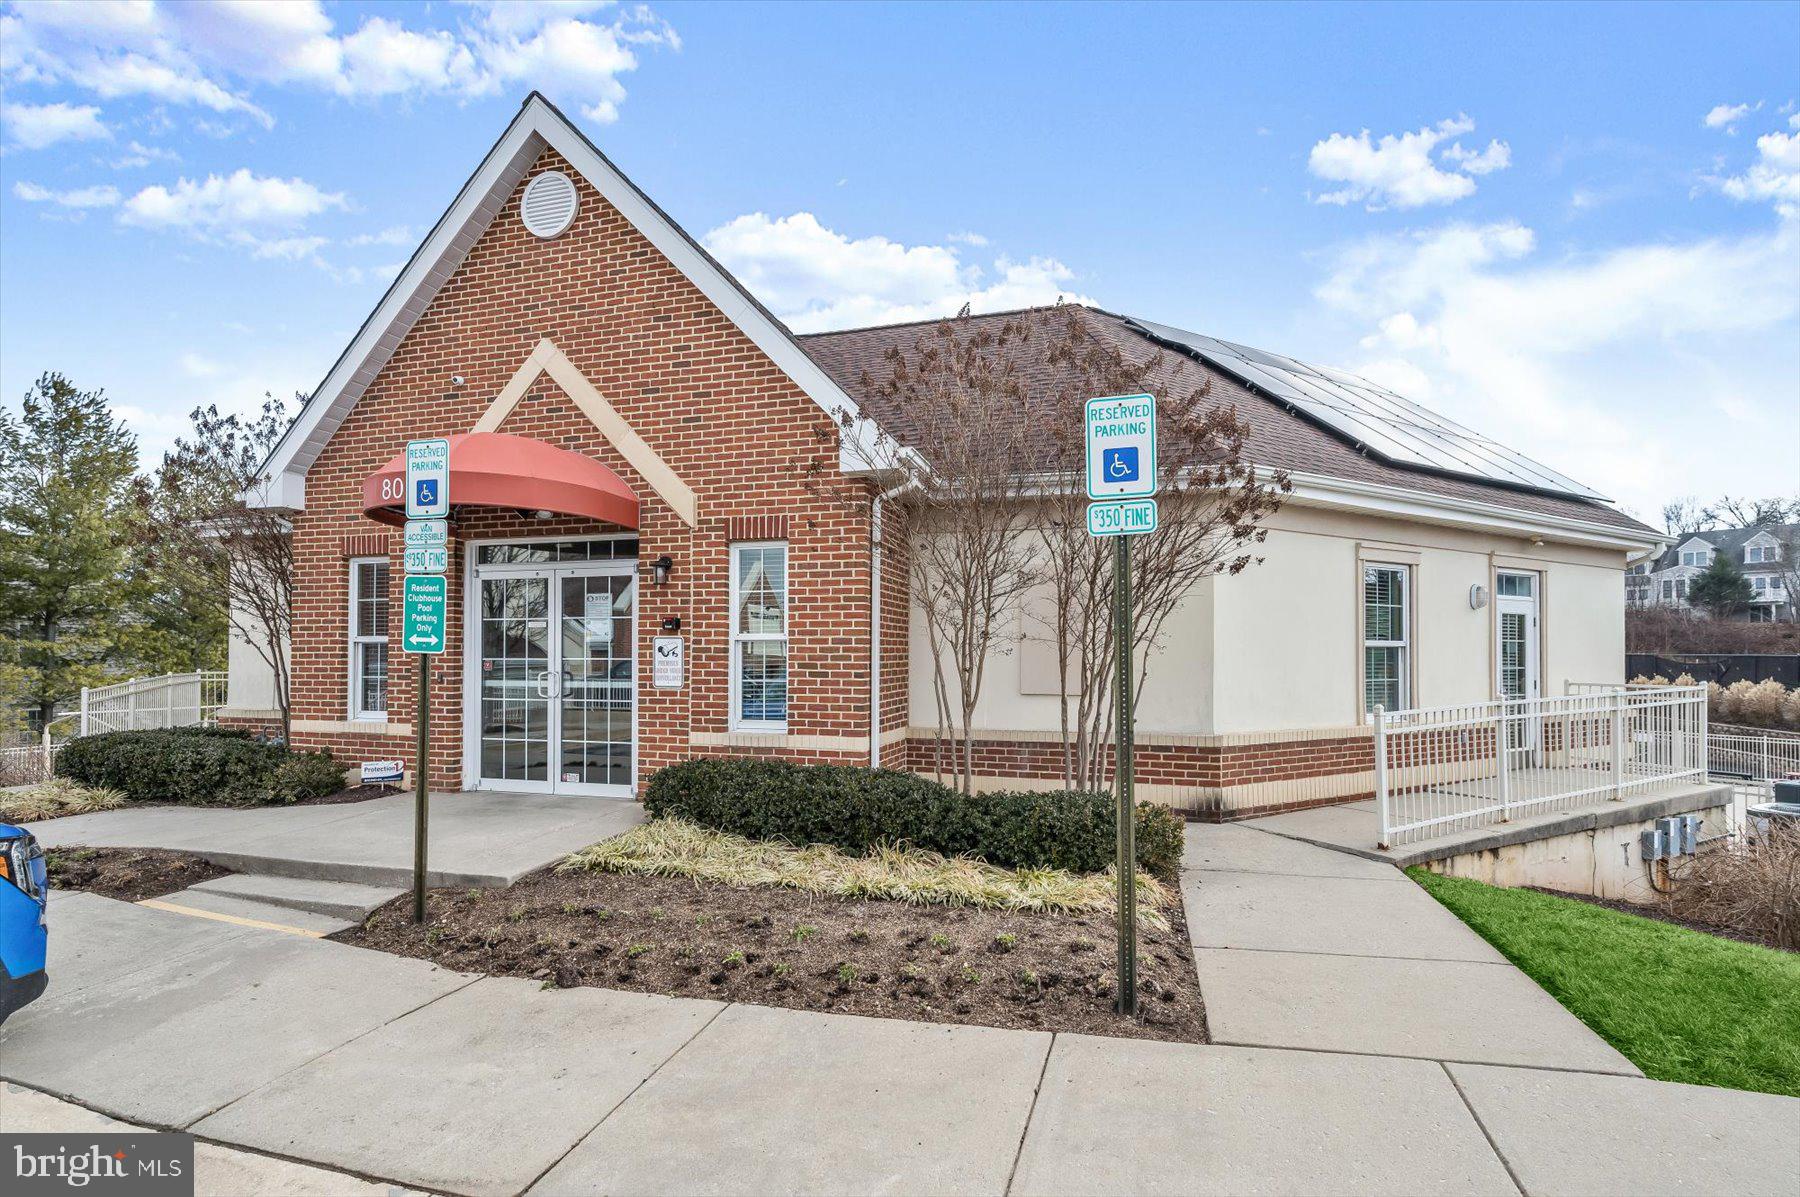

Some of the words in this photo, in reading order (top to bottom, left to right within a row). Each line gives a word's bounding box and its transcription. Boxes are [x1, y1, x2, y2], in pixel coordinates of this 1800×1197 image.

[1090, 404, 1150, 421] RESERVED
[1095, 421, 1147, 438] PARKING
[410, 447, 445, 459] RESERVED
[411, 460, 443, 471] PARKING
[1094, 508, 1120, 528] $350
[1124, 507, 1151, 526] FINE
[420, 525, 433, 533] VAN
[408, 532, 444, 541] ACCESSIBLE
[428, 552, 446, 567] FINE
[411, 583, 440, 592] Resident
[407, 593, 443, 602] Clubhouse
[417, 603, 433, 612] Pool
[411, 613, 438, 624] Parking
[416, 623, 433, 634] Only
